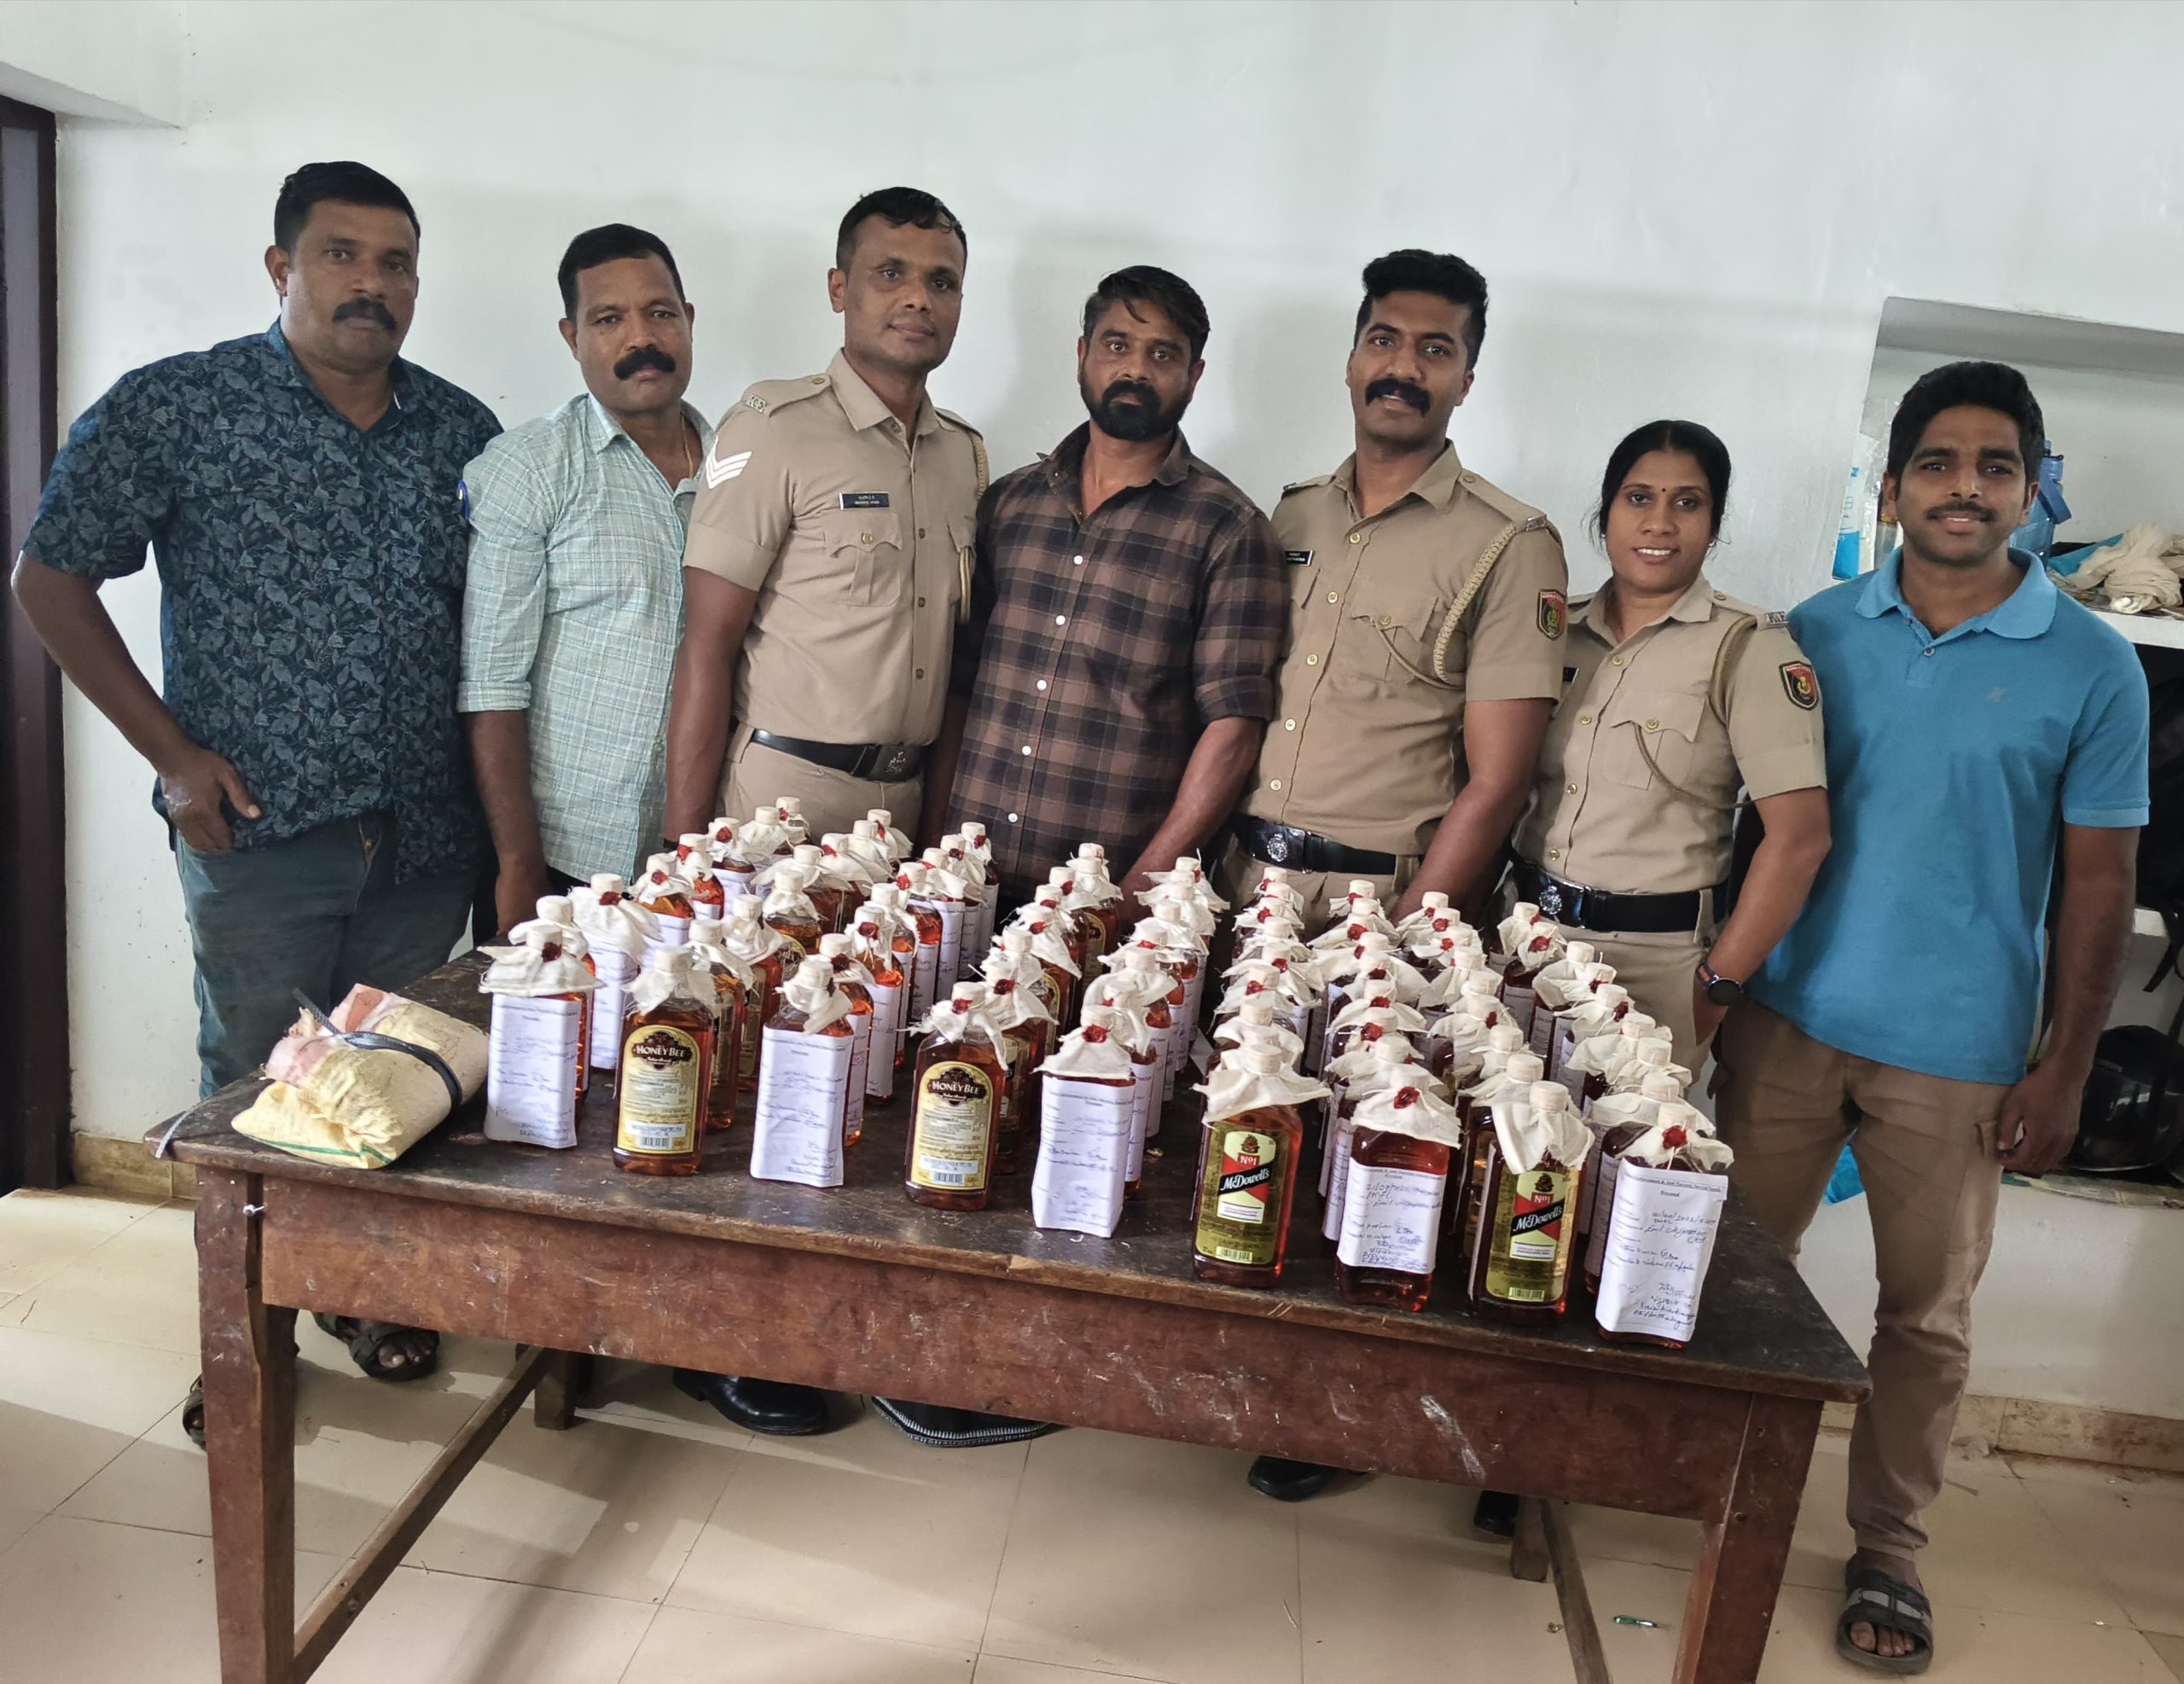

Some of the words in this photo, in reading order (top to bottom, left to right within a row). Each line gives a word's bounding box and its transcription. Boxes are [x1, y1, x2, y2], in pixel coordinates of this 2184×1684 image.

[636, 1045, 668, 1055] HONEY
[669, 1047, 686, 1057] BEE
[932, 1081, 964, 1091] HONEY
[964, 1084, 979, 1095] BEE
[1220, 1168, 1269, 1191] McDowell's
[1513, 1205, 1563, 1231] McDowell's
